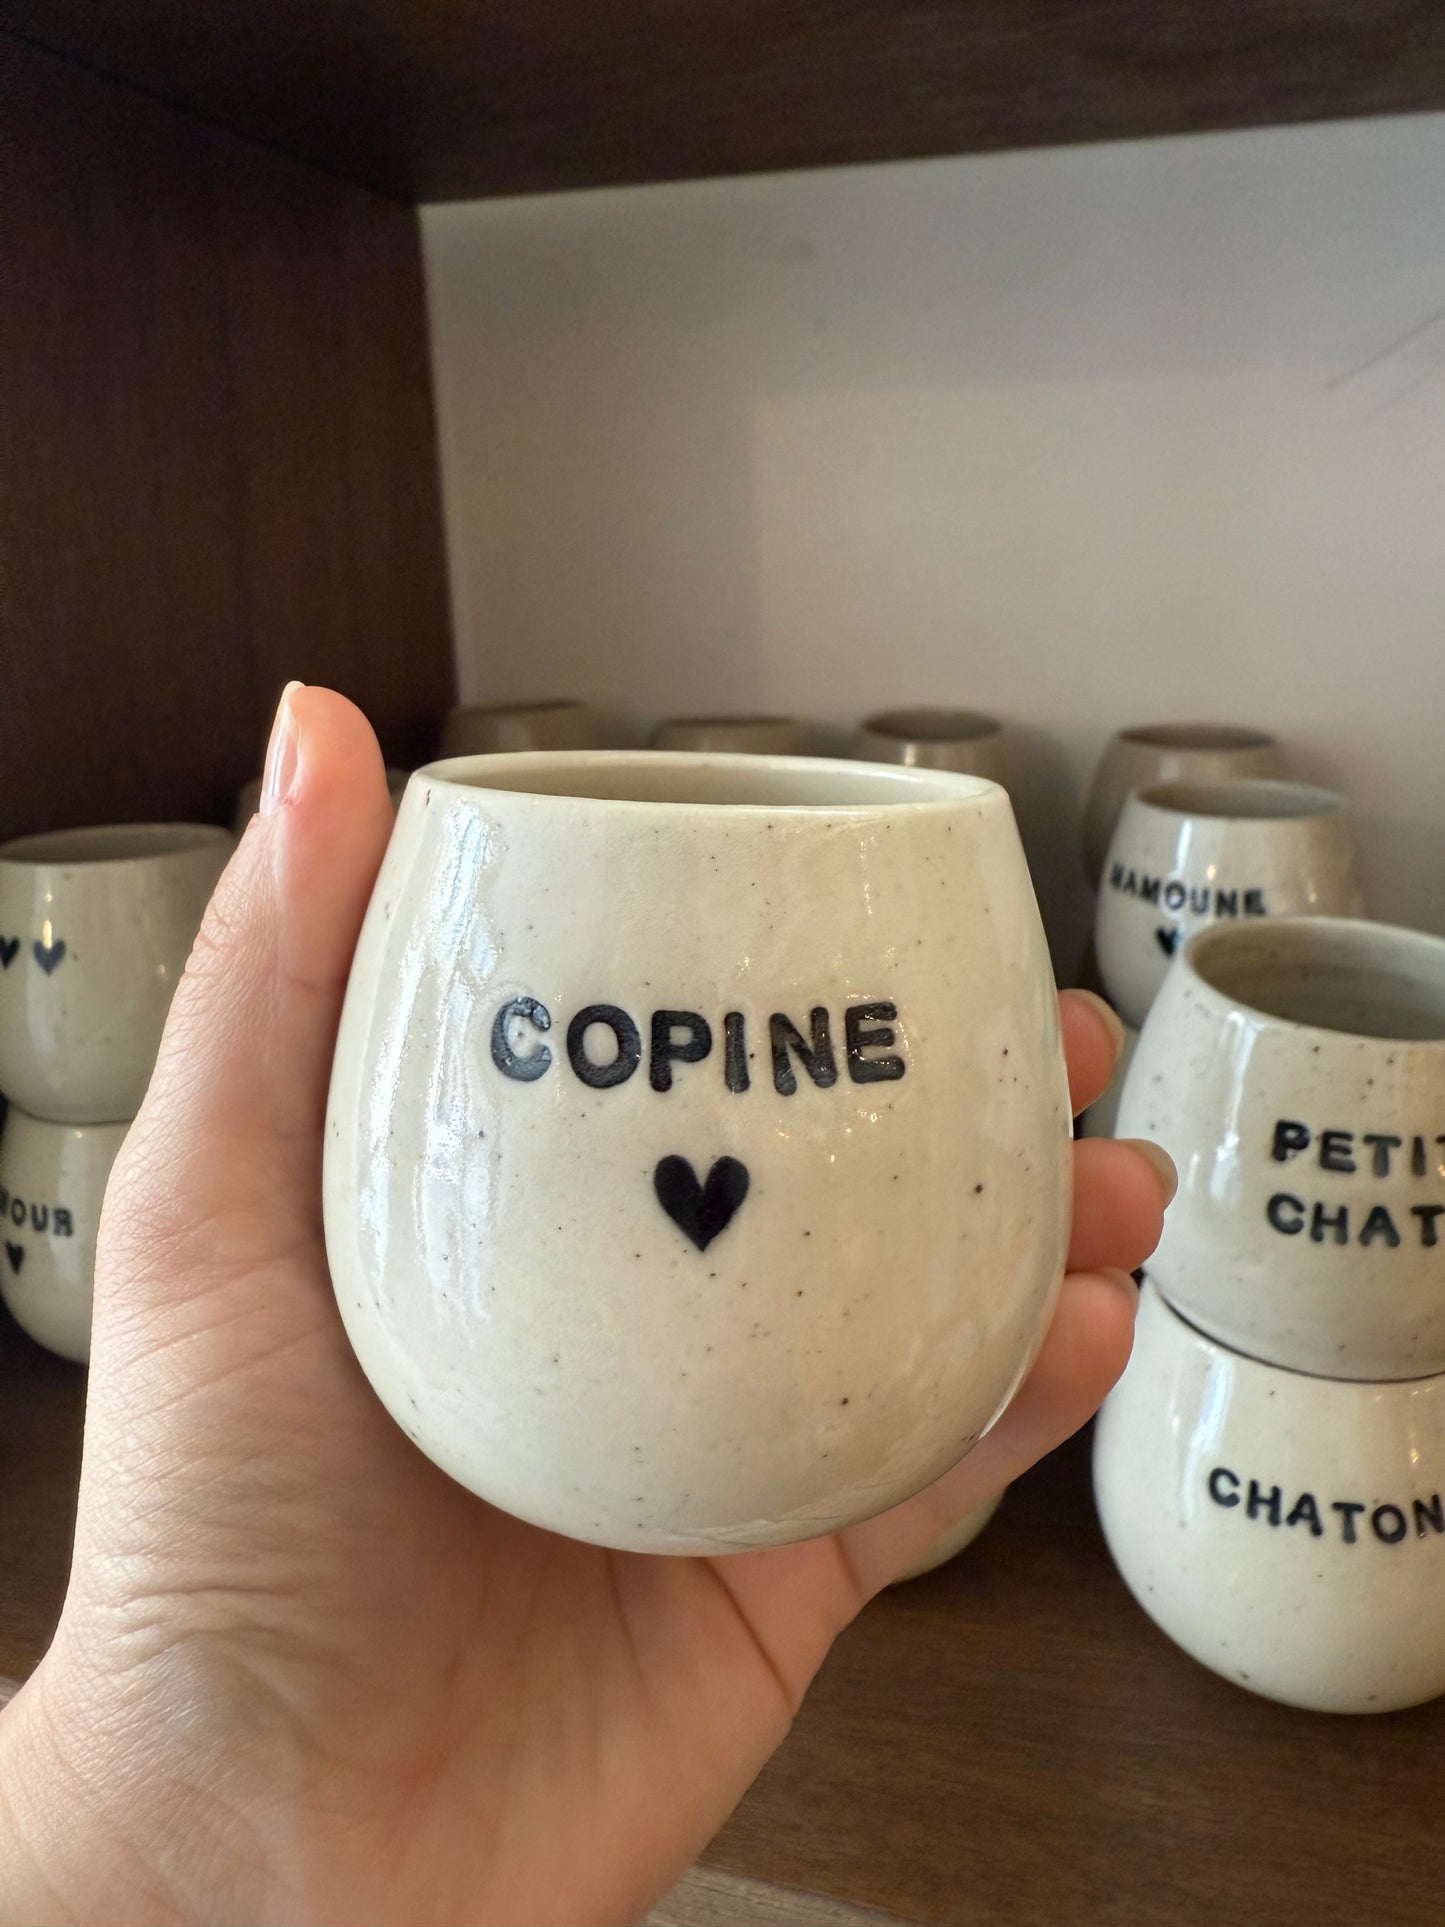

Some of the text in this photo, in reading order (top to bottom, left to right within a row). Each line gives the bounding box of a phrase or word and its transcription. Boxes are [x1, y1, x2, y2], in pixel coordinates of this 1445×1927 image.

[490, 996, 906, 1096] COPINE
[1267, 1193, 1445, 1248] CHAT
[1208, 1467, 1445, 1544] CHATON
